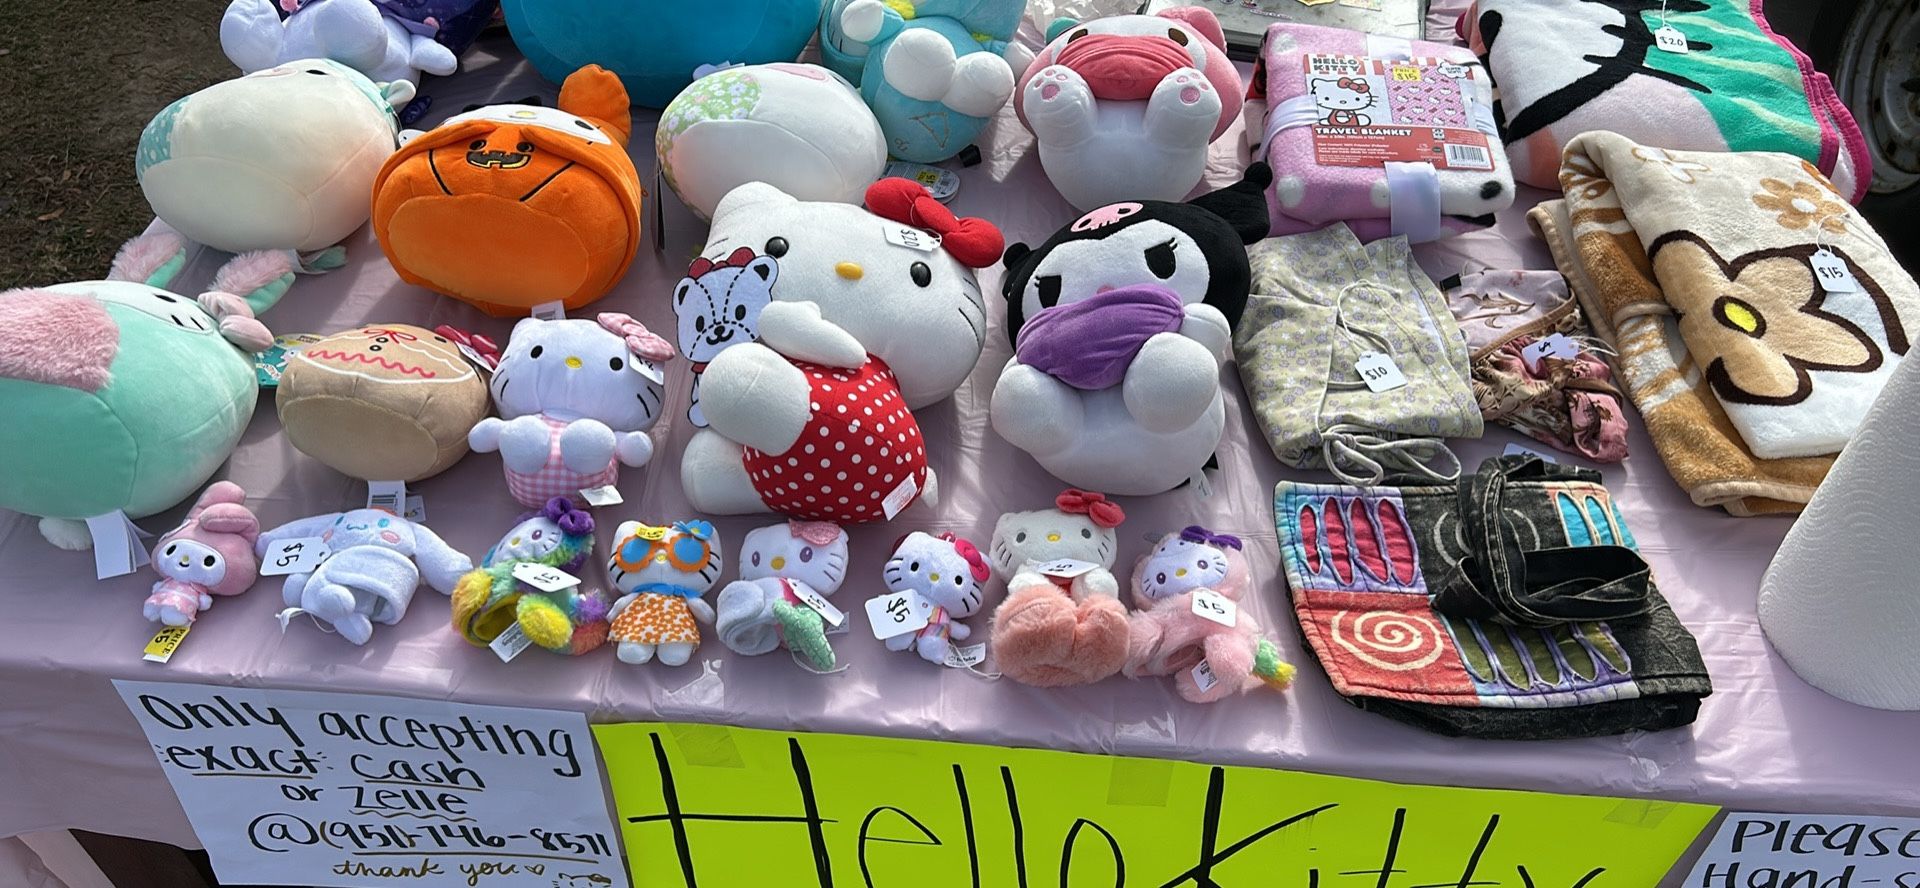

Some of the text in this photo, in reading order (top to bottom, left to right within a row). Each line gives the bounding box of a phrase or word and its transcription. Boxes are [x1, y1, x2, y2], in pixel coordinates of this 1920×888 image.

[1659, 36, 1684, 46] $20
[1312, 57, 1358, 65] HELLO
[1315, 127, 1412, 136] TRAVEL BLANKET
[900, 229, 920, 247] $20
[1818, 266, 1844, 279] $15
[1364, 366, 1388, 380] $10
[276, 542, 305, 567] $5
[533, 572, 560, 584] $5
[807, 594, 826, 610] $5
[886, 597, 911, 623] $5
[1198, 598, 1226, 614] $5
[154, 628, 176, 643] $5
[162, 628, 187, 655] PRICE
[138, 694, 582, 777] Only accepting
[165, 745, 320, 774] exact
[280, 784, 324, 802] or
[627, 732, 1126, 888] Hello
[1731, 820, 1920, 859] Please
[333, 857, 520, 887] thank you
